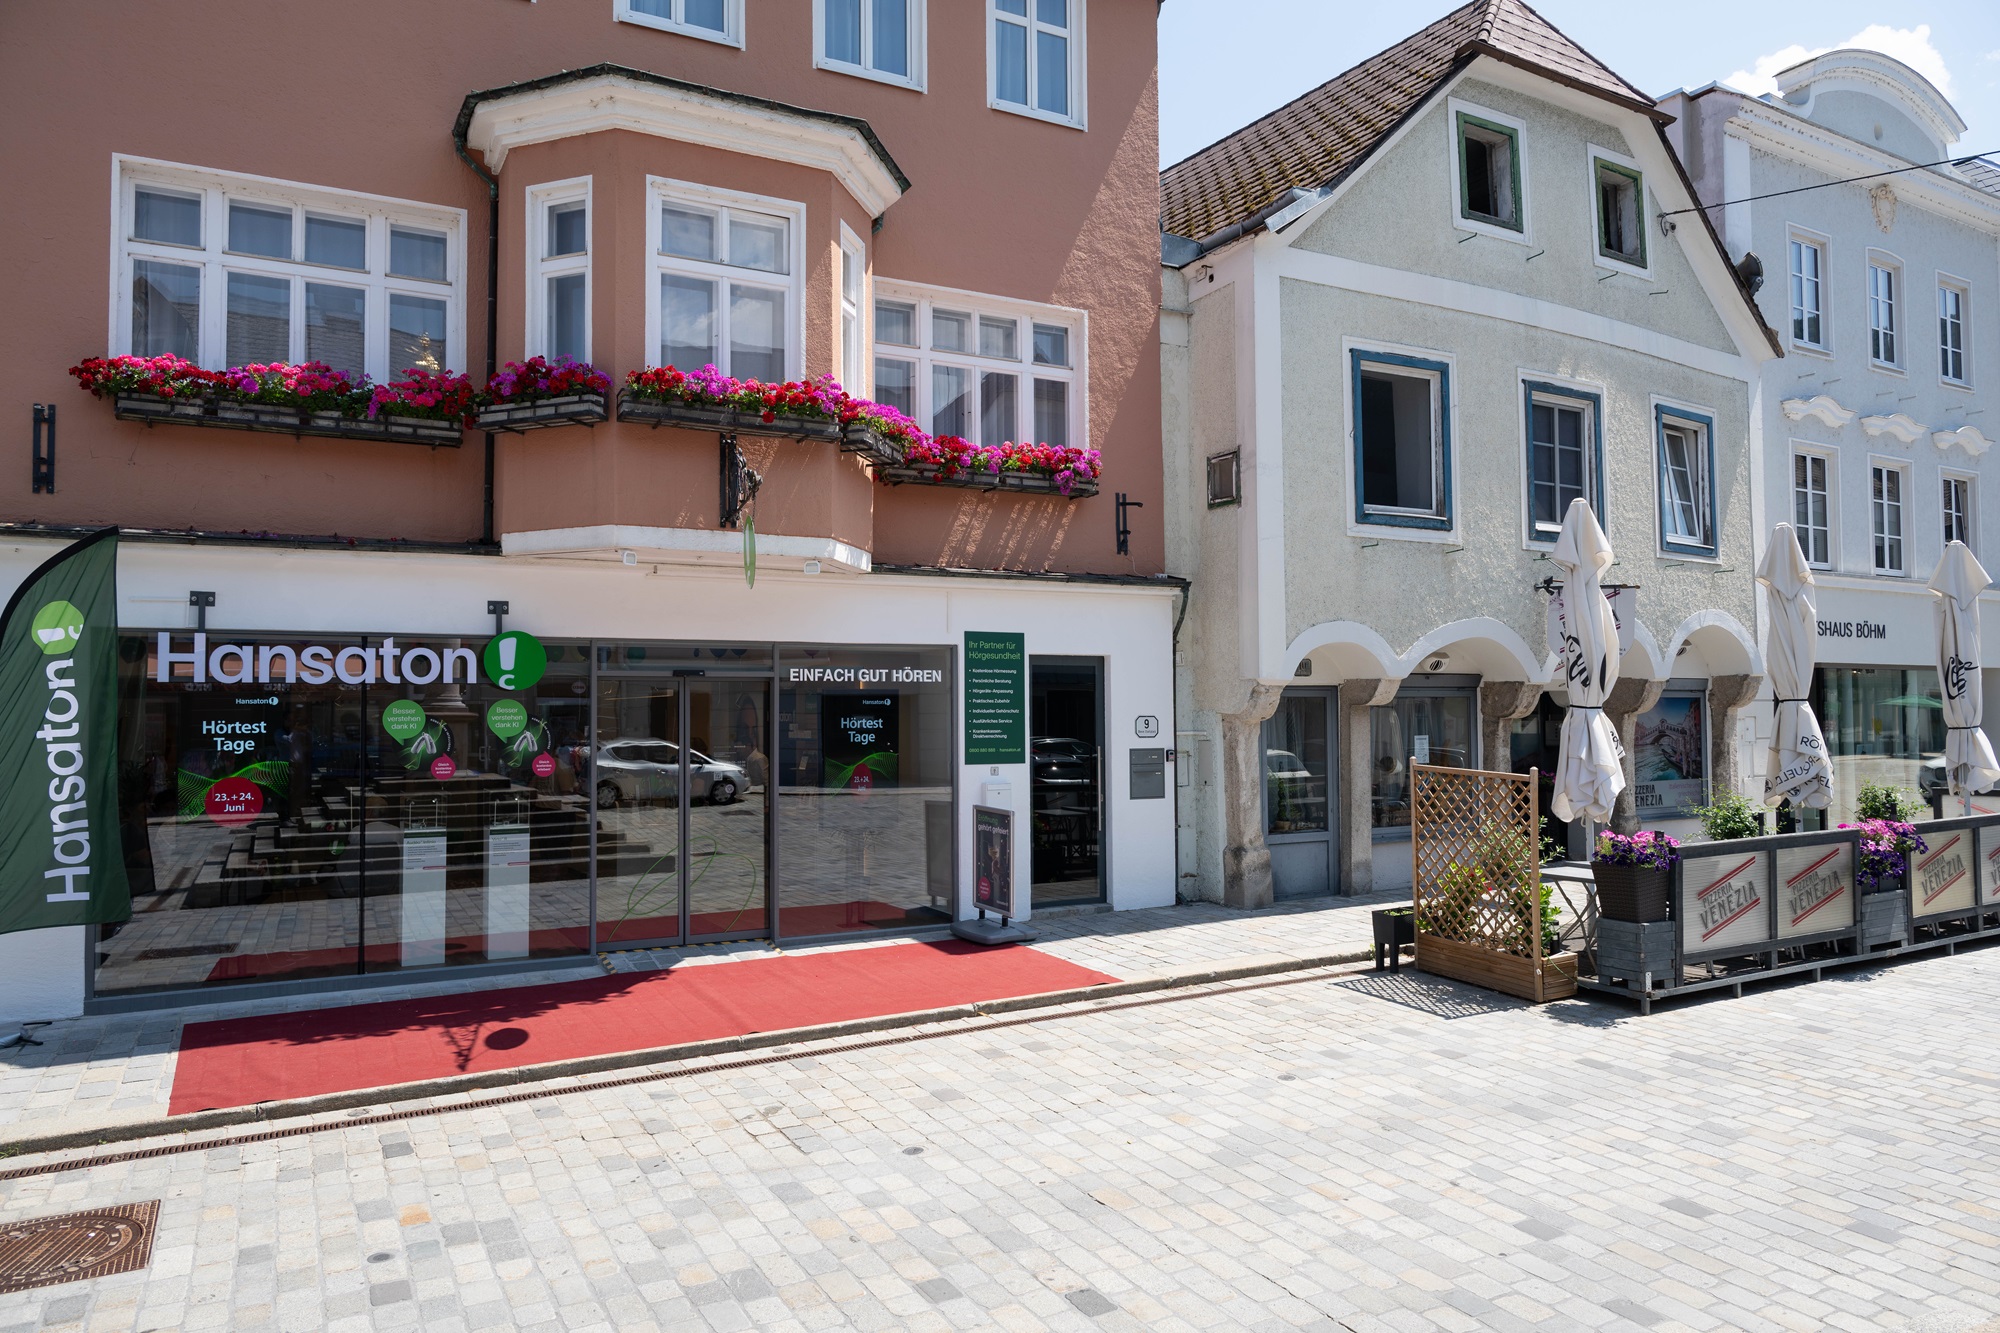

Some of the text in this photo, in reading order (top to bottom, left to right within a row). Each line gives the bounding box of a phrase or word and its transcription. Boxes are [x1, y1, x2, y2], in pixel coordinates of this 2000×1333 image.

[1816, 620, 1886, 639] SHAUS BÖHM
[968, 640, 1016, 650] Ihr Partner für
[156, 631, 478, 685] Hansaton
[968, 651, 1021, 661] Hörgesundheit
[789, 666, 942, 683] EINFACH GUT HÖREN
[202, 720, 267, 735] Hörtest
[840, 717, 884, 729] Hörtest
[1143, 718, 1150, 729] 9
[213, 737, 256, 754] Tage
[848, 731, 876, 745] Tage
[36, 657, 91, 903] Hansaton
[214, 793, 230, 802] 23.
[239, 792, 254, 800] 24.
[1635, 784, 1656, 795] ZZERIA
[223, 803, 245, 812] Juni
[1635, 793, 1664, 808] ENEZIA
[978, 813, 999, 825] Eröffnung
[1921, 853, 1965, 896] VENEZIA
[1923, 854, 1946, 879] PIZZERIA
[1793, 870, 1820, 895] PIZZERIA
[1702, 881, 1734, 909] PIZZERIA
[1790, 870, 1842, 915] VENEZIA
[1700, 880, 1758, 930] VENEZIA
